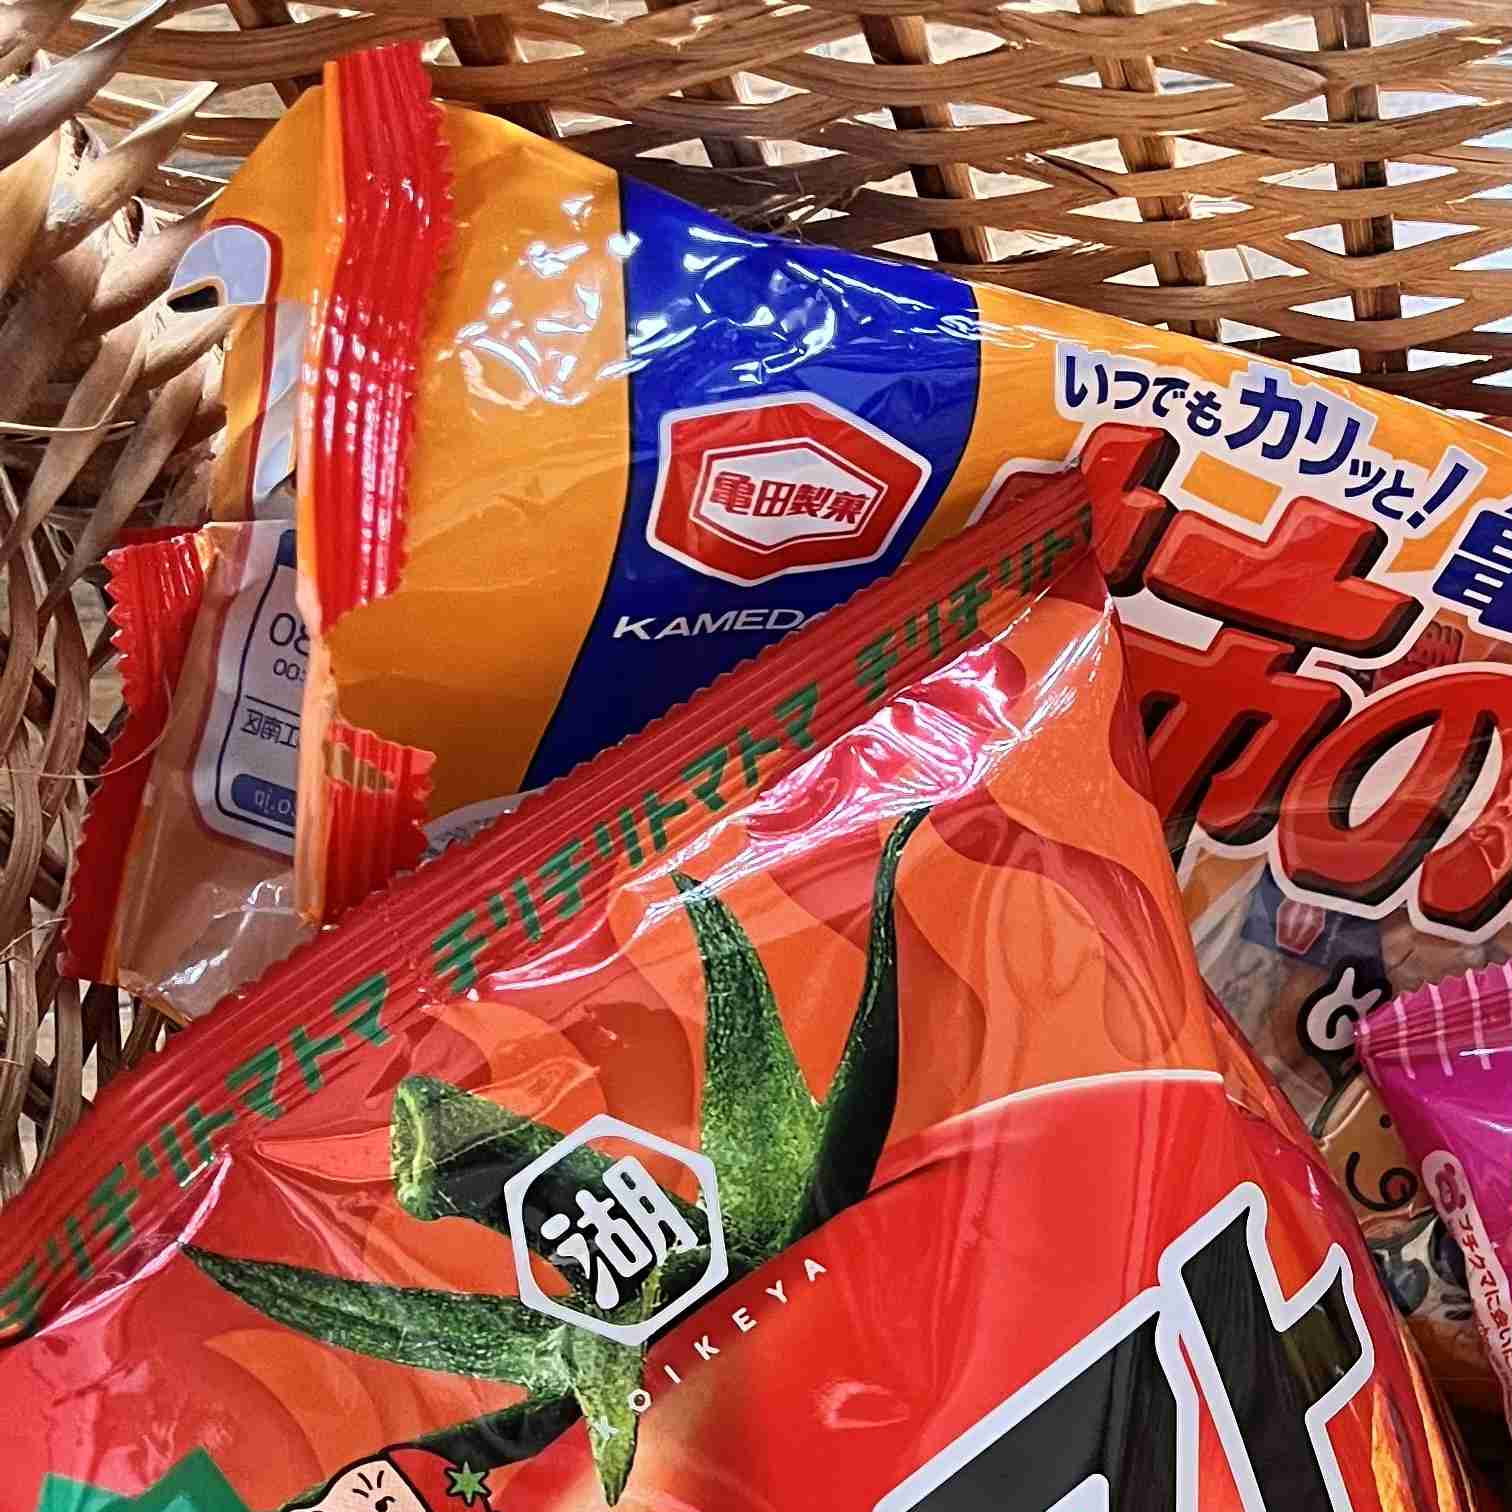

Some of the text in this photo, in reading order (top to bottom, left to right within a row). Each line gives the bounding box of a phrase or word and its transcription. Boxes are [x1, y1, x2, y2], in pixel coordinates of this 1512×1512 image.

[709, 471, 871, 525] 亀田製菓
[612, 608, 806, 641] KAMED
[539, 1153, 700, 1310] 湖
[596, 1256, 829, 1441] KOIKEYA
